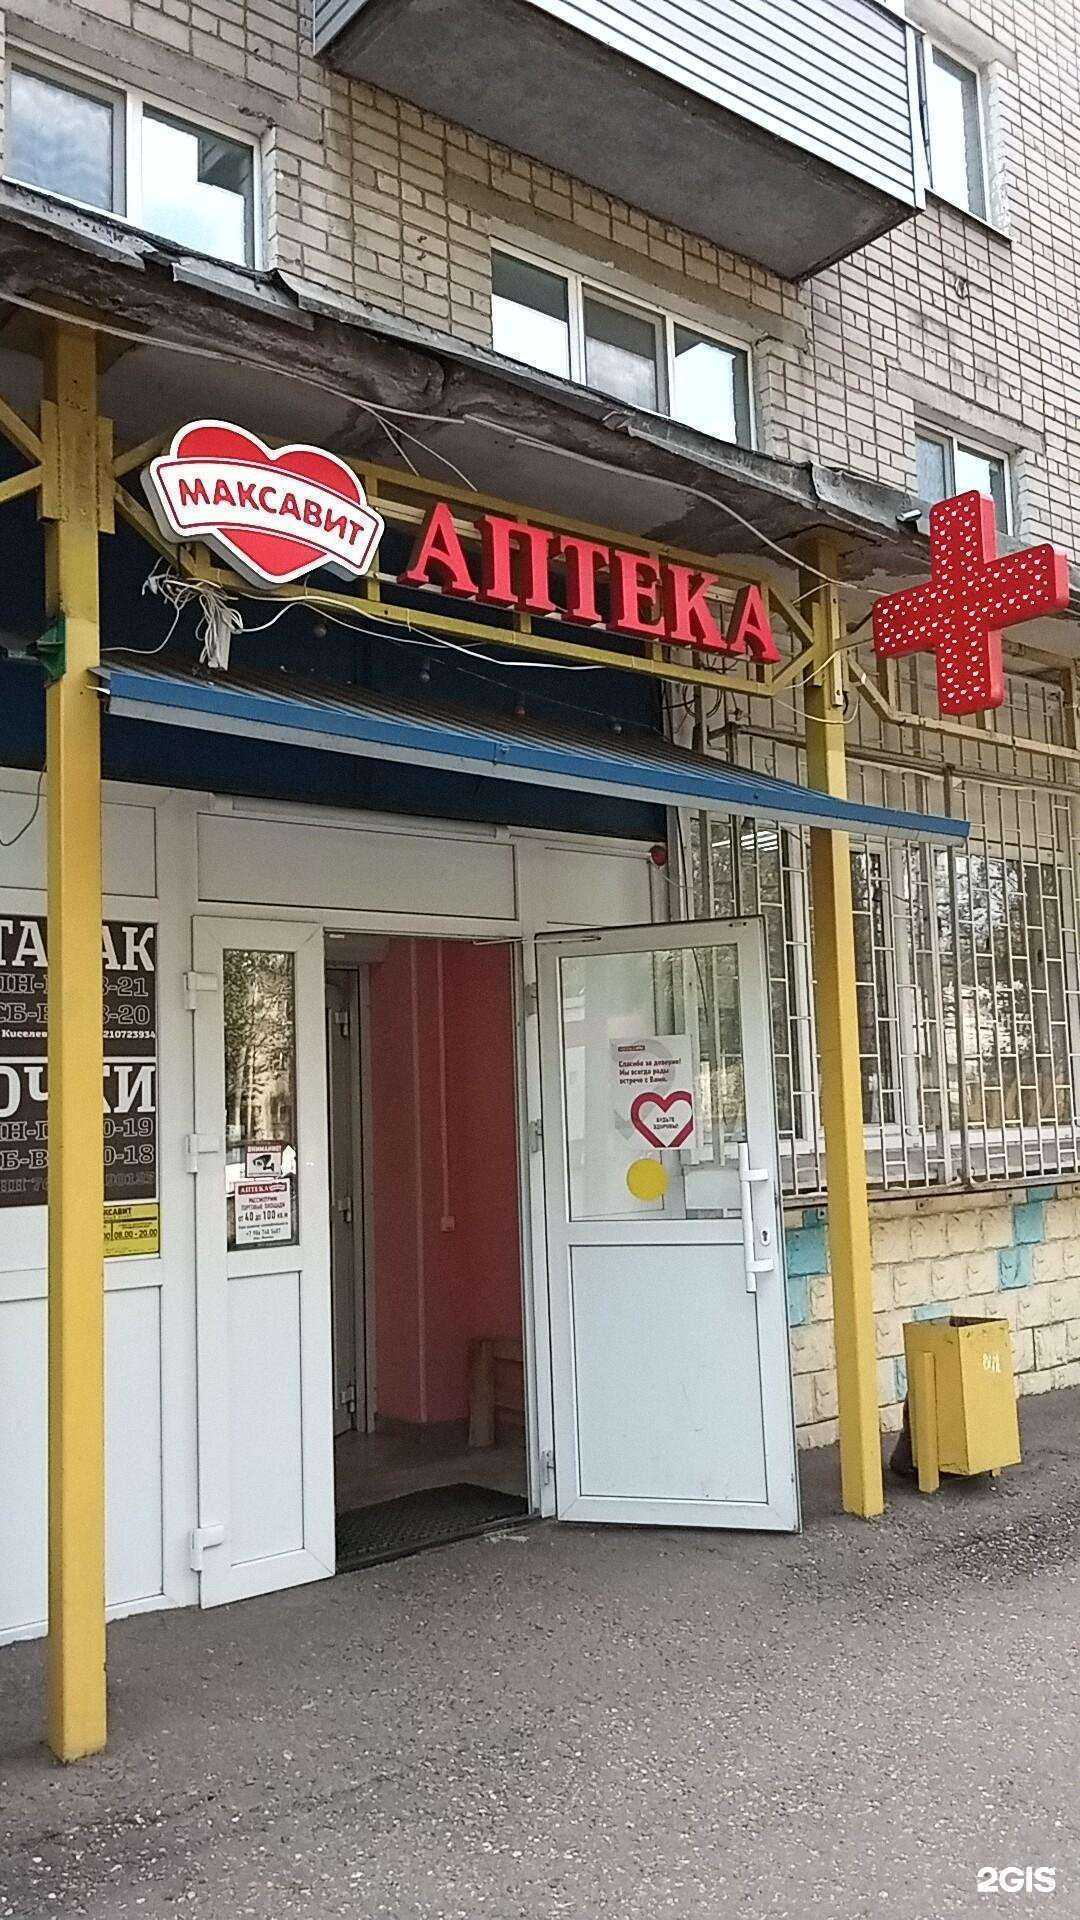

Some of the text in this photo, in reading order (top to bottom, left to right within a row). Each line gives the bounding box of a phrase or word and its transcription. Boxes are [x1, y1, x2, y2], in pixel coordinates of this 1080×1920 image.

[178, 478, 365, 546] МАКСАВИТ
[400, 502, 781, 664] АПТЕКА
[1, 1028, 156, 1039] Киселев 210723934
[245, 1211, 254, 1221] 40
[263, 1210, 276, 1220] 100
